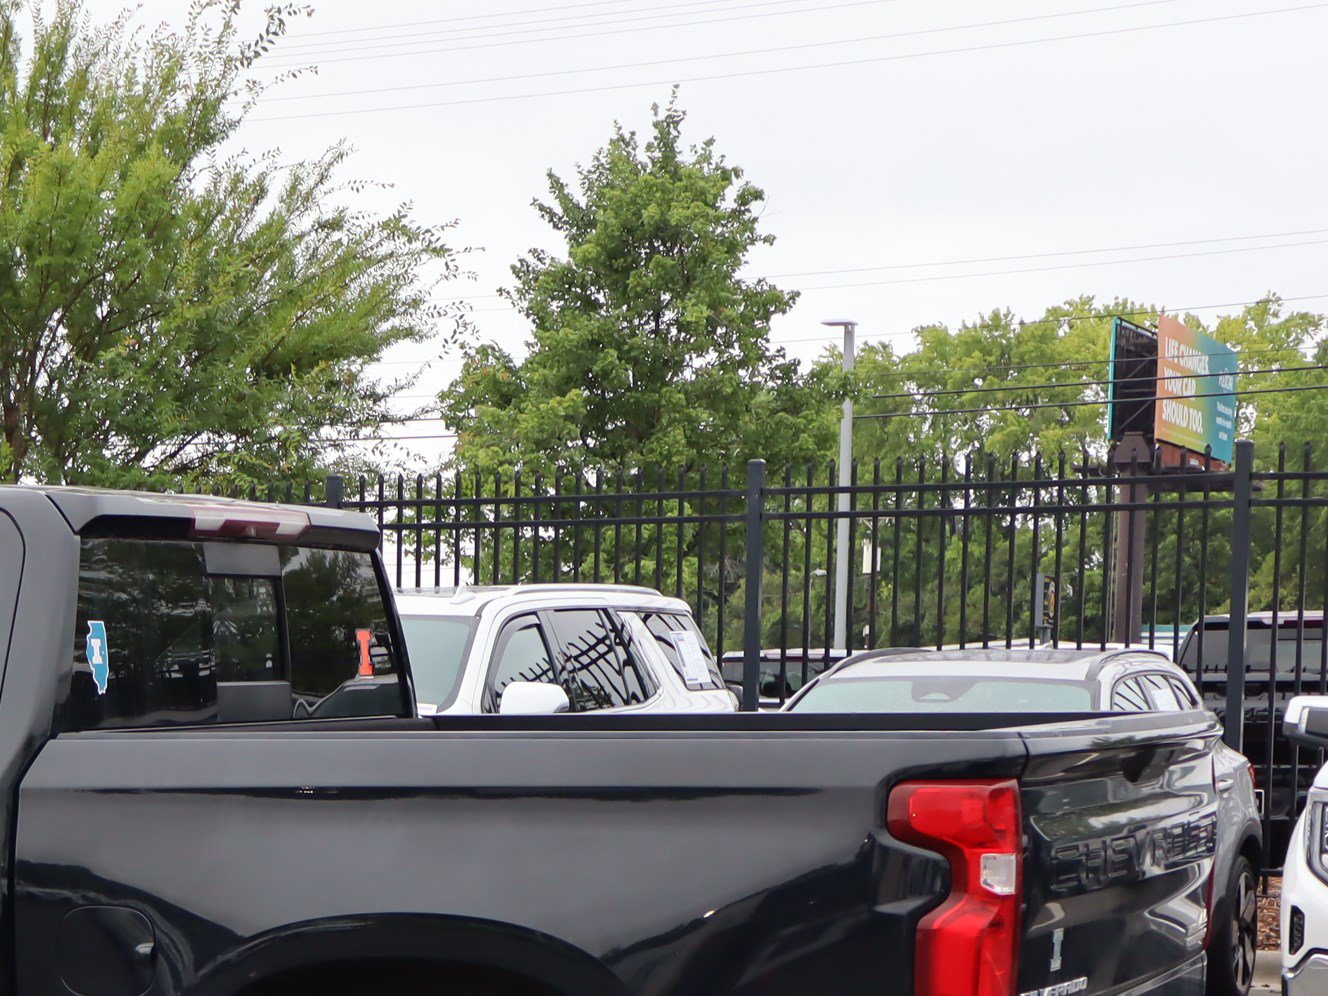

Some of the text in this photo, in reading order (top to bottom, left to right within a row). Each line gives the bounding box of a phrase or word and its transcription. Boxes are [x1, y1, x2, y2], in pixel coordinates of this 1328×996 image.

[1165, 336, 1210, 377] LIFE CHANGES
[1164, 366, 1182, 396] YOUR
[1182, 376, 1196, 401] CAR
[1162, 399, 1188, 429] SHOULD
[1189, 409, 1203, 434] TOO.
